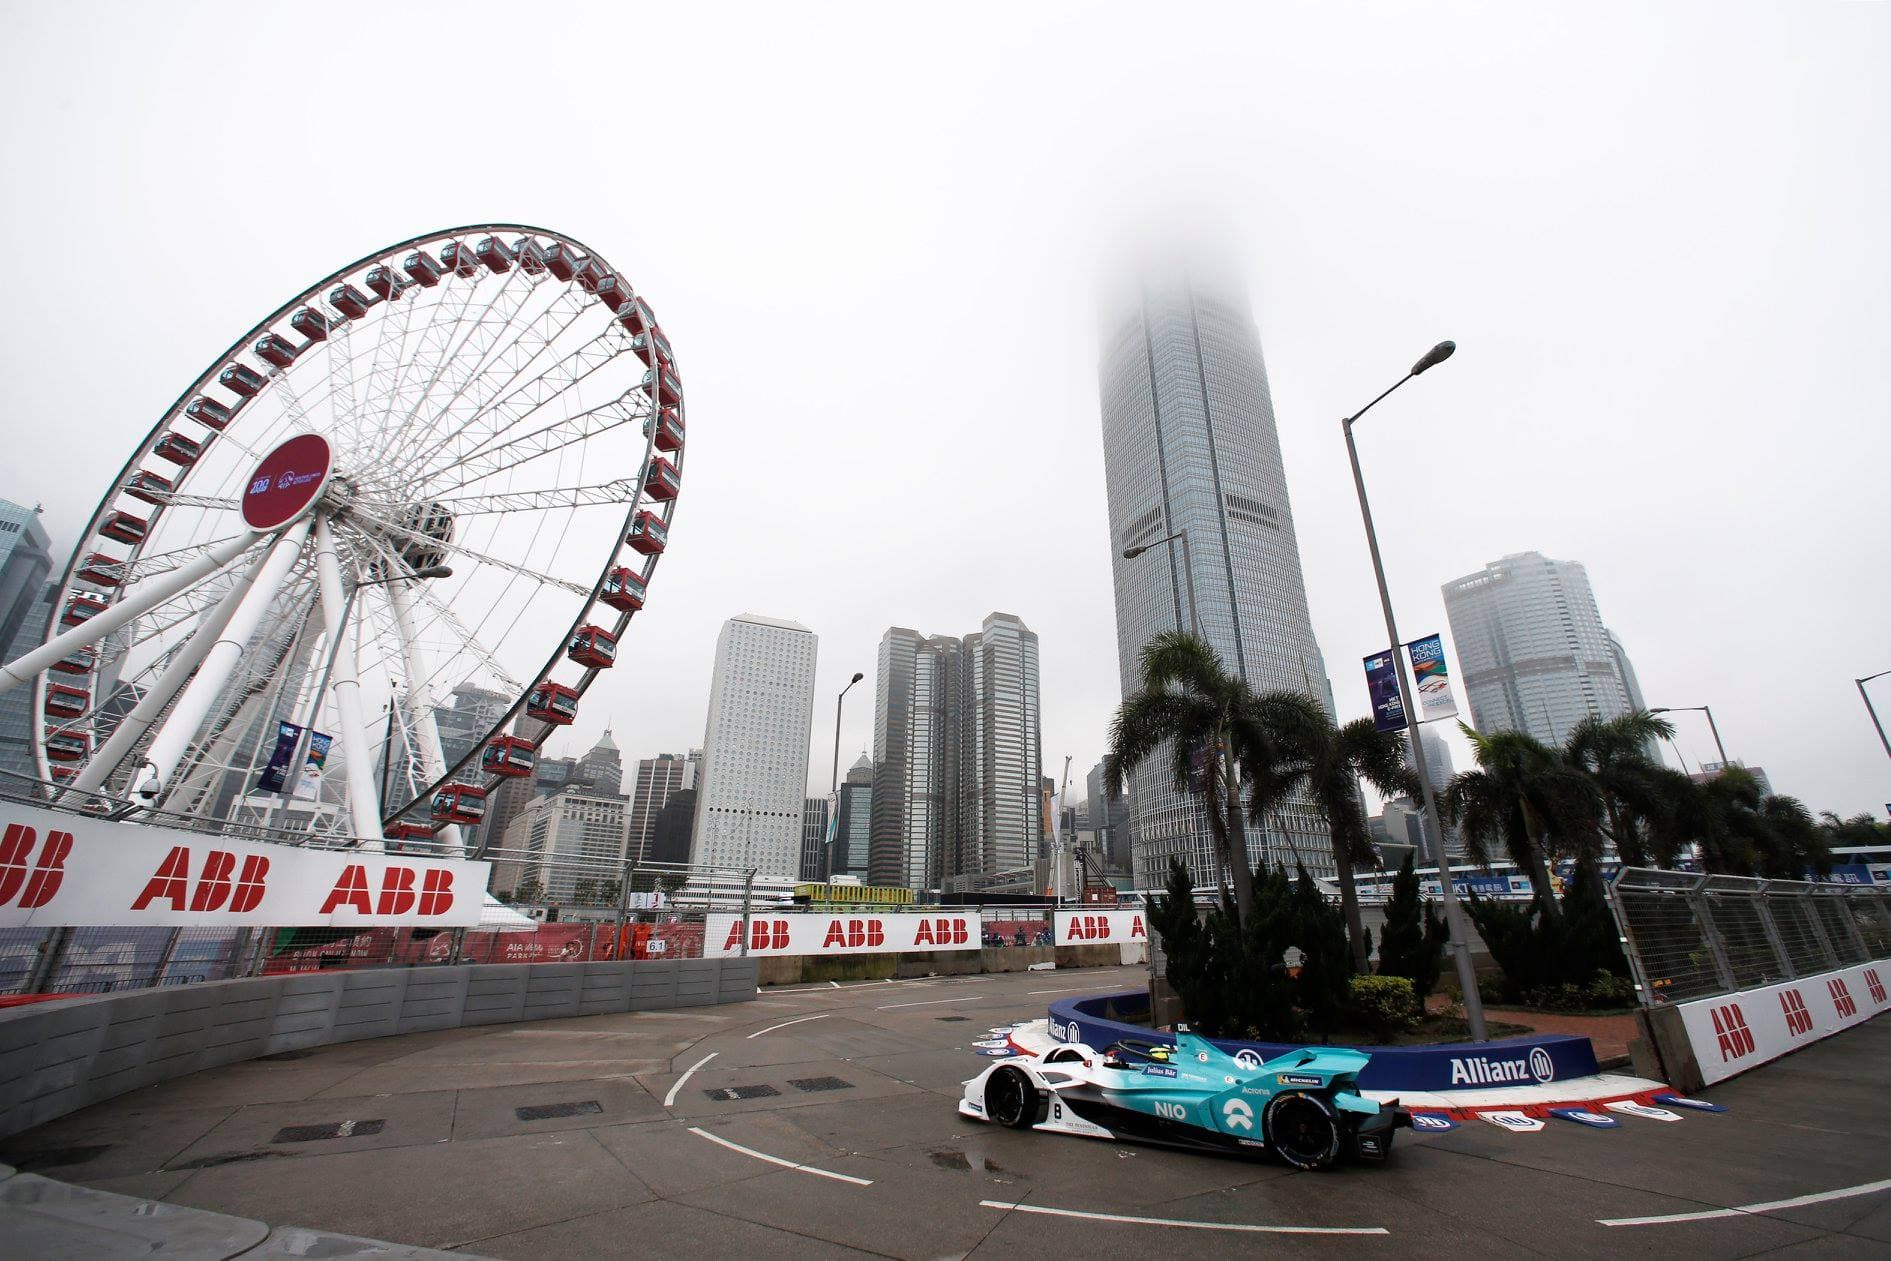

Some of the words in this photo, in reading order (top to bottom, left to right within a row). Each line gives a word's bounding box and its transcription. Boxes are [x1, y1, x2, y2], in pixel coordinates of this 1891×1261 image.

[1411, 640, 1440, 655] HONG
[1412, 648, 1441, 662] KONG
[130, 846, 270, 912] ABB
[319, 864, 454, 915] ABB
[723, 920, 791, 951] ABB
[823, 919, 885, 948] ABB
[914, 918, 968, 945] ABB
[1067, 916, 1111, 940] ABB
[649, 942, 664, 951] 6.1
[1826, 978, 1857, 1019] ABB
[1862, 968, 1888, 1004] ABB
[1778, 988, 1814, 1037] ABB
[1709, 1003, 1756, 1062] ABB
[1147, 1066, 1164, 1075] Julius
[1164, 1068, 1176, 1077] Bär
[1290, 1077, 1320, 1085] MICHELIN
[1450, 1057, 1530, 1085] Allianz
[1241, 1086, 1270, 1096] Acronis
[1154, 1100, 1187, 1120] NIO
